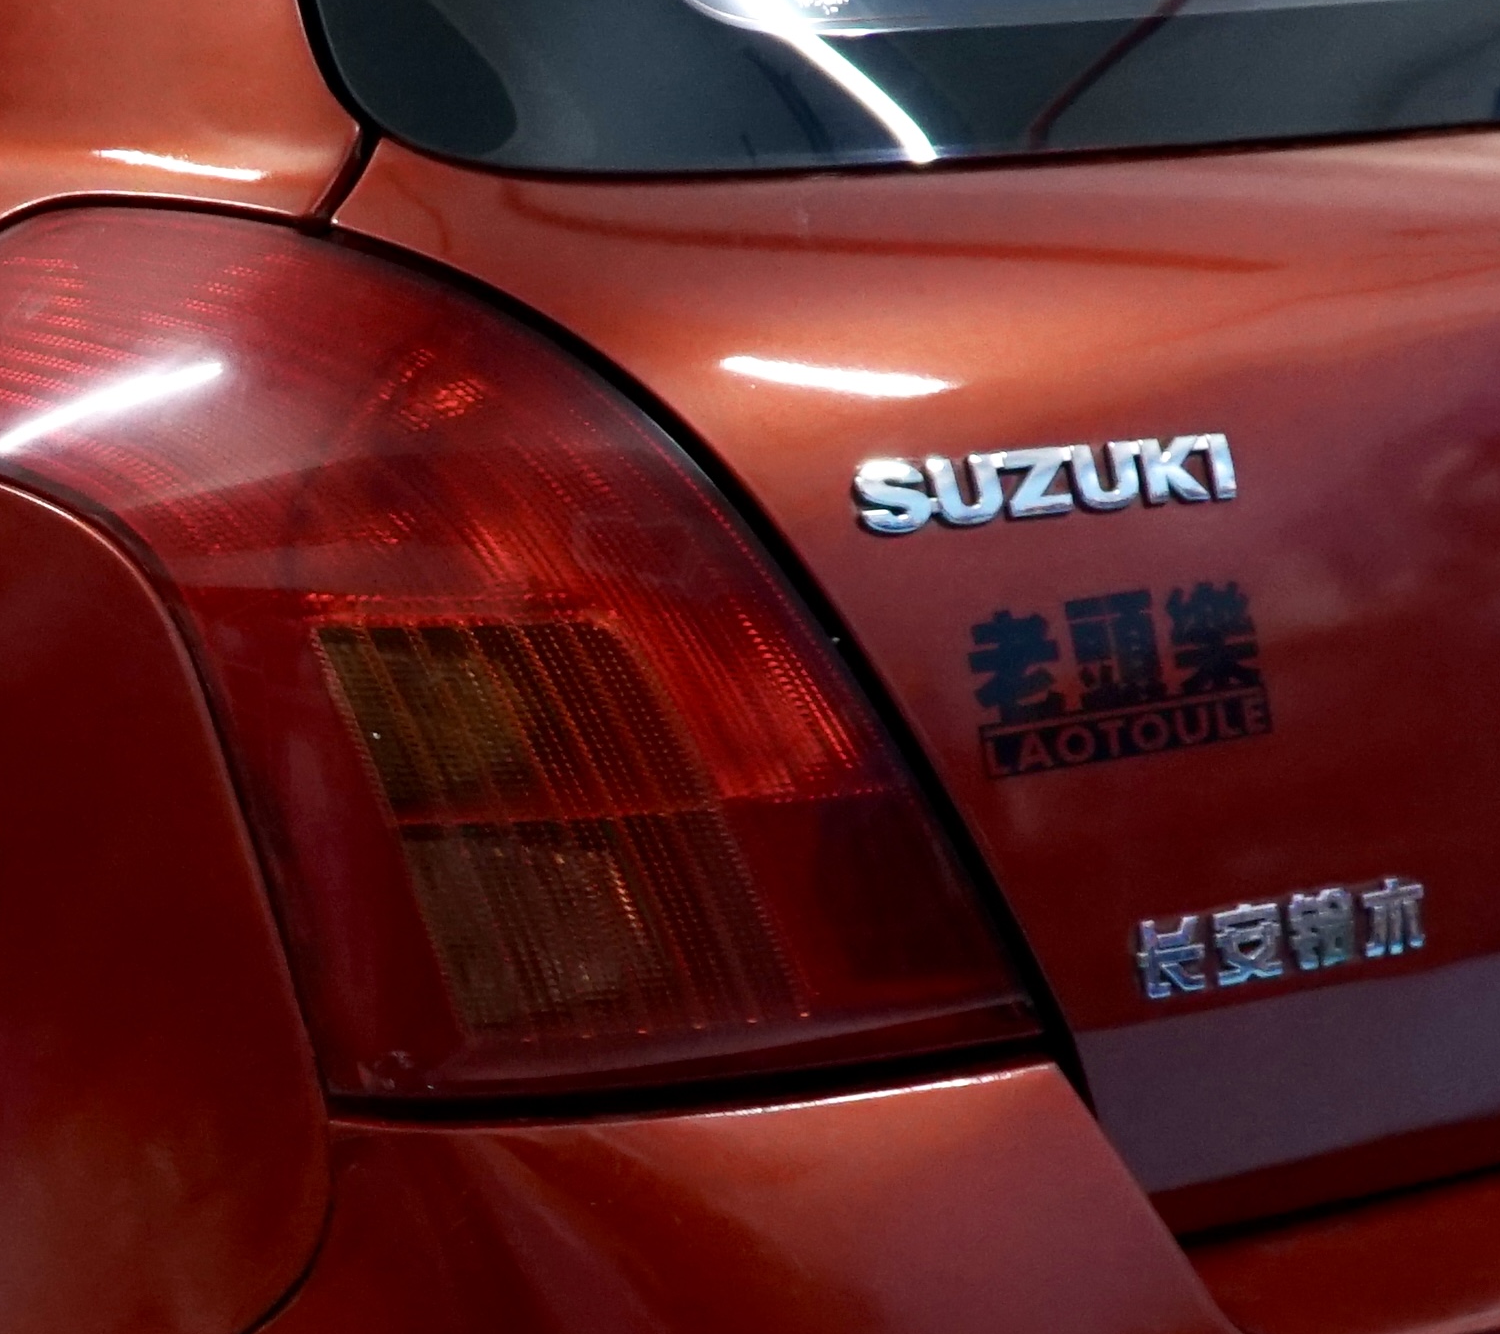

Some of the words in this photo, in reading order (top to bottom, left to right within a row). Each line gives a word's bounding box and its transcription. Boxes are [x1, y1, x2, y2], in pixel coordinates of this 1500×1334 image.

[853, 433, 1238, 535] SUZUKI
[967, 580, 1260, 724] 老頭樂
[983, 697, 1269, 775] LAOTOULE
